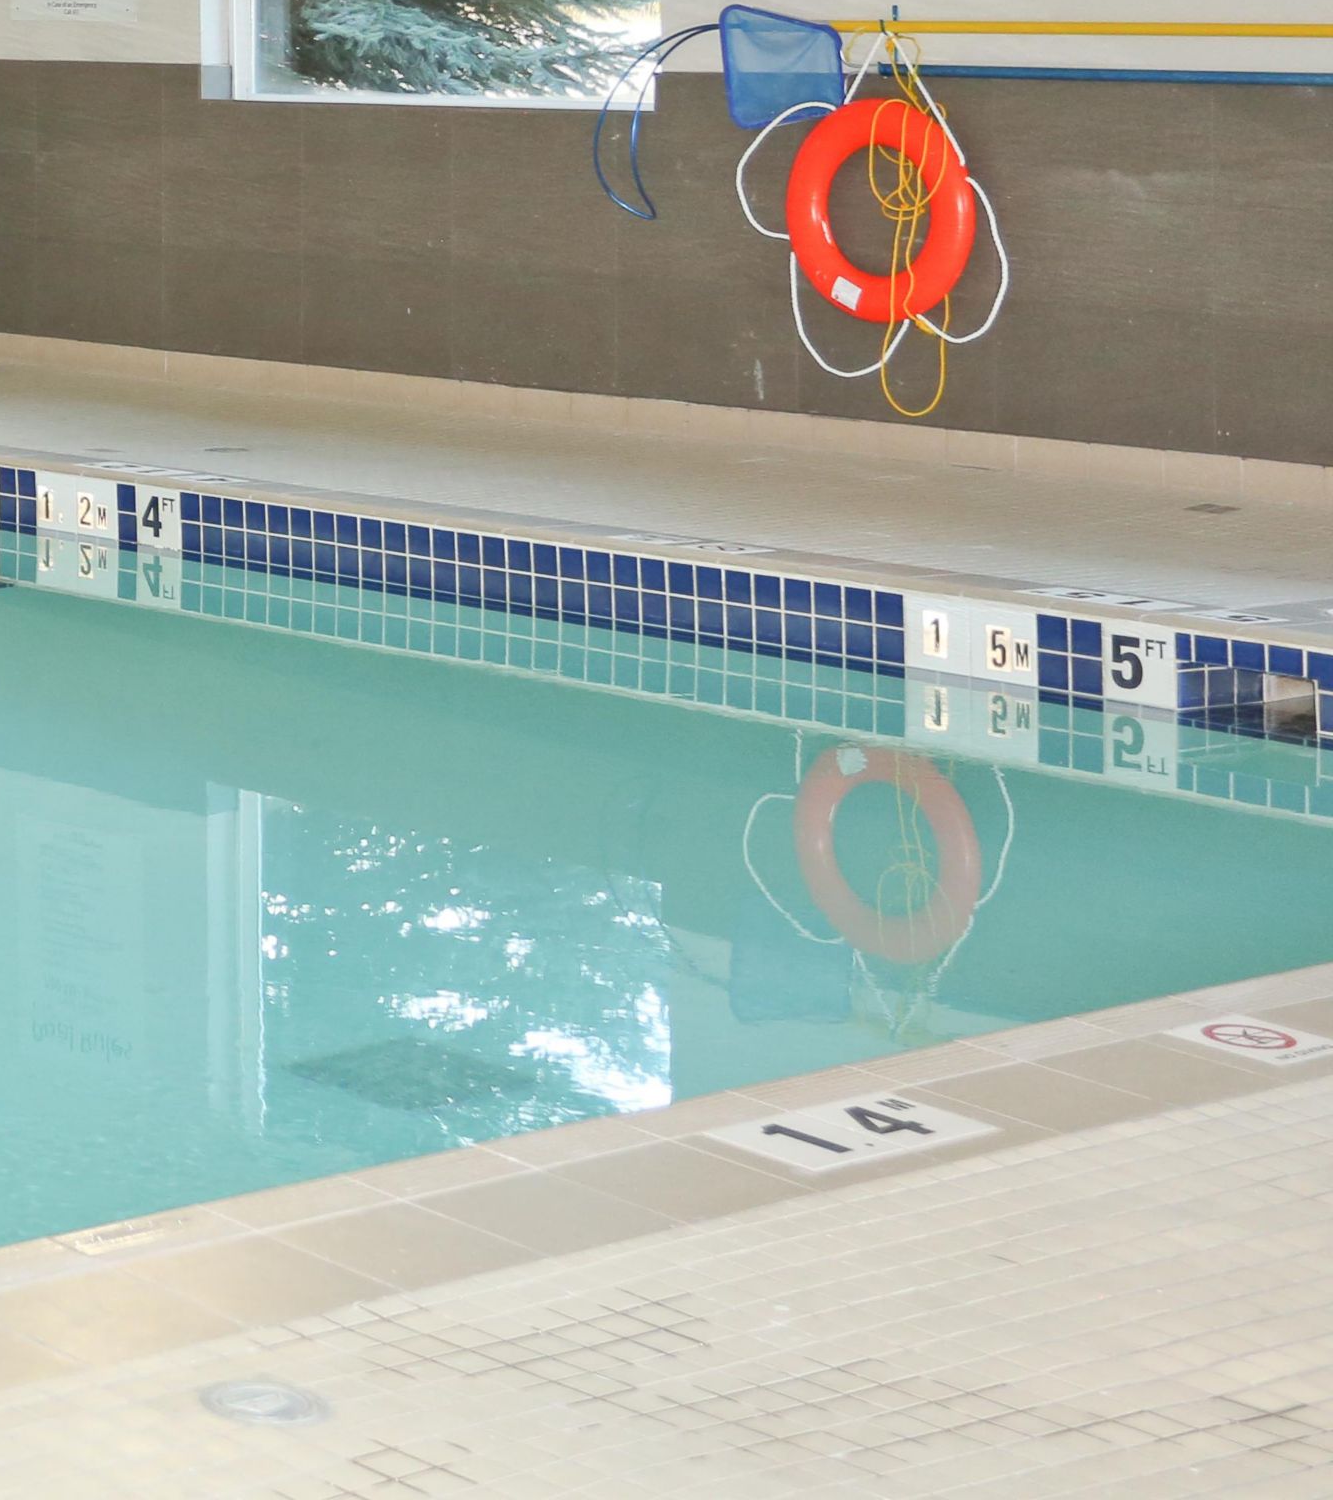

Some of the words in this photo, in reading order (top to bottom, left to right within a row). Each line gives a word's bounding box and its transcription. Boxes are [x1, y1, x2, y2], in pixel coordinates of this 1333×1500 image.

[80, 496, 92, 526] 2
[142, 496, 162, 538] 4
[162, 498, 175, 513] FT
[990, 630, 1006, 668] 5
[1016, 643, 1029, 668] M
[1111, 634, 1143, 689] 5
[1145, 639, 1167, 660] FT
